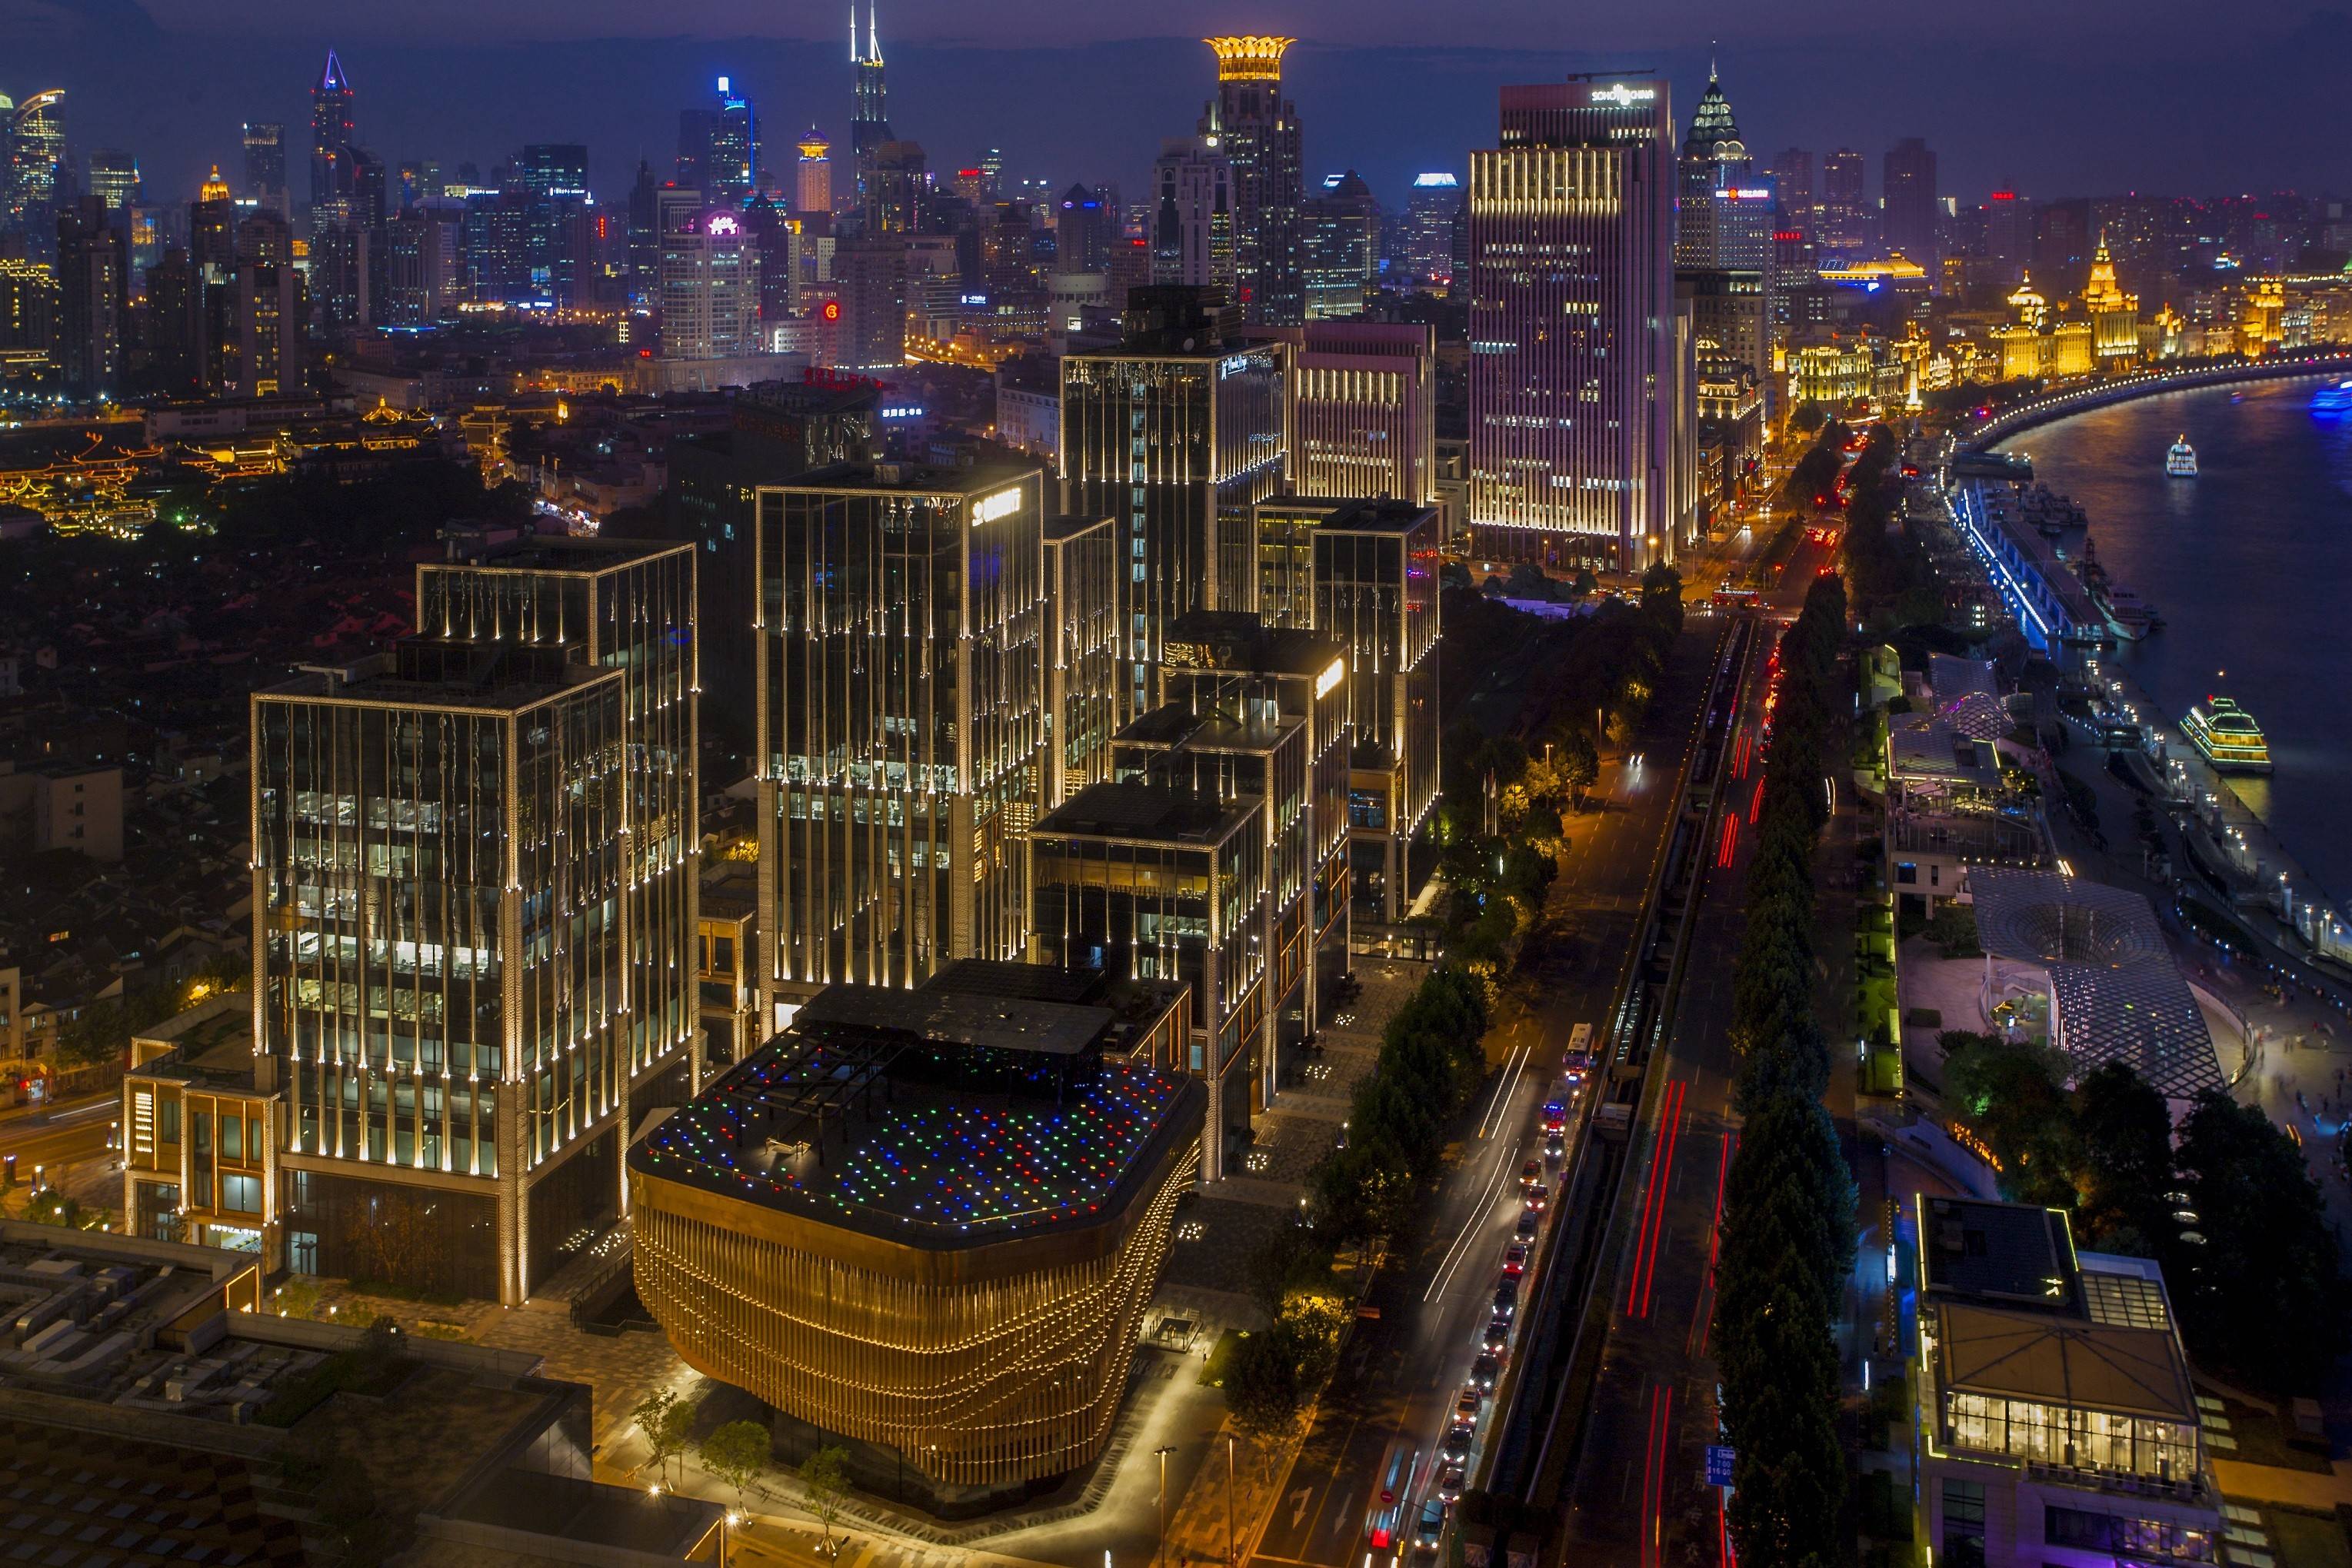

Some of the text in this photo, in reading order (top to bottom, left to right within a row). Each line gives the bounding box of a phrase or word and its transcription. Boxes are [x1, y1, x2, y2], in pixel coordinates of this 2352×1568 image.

[1591, 89, 1654, 101] SOHO CHINA
[1717, 1460, 1731, 1469] 700
[1712, 1467, 1731, 1476] 1600
